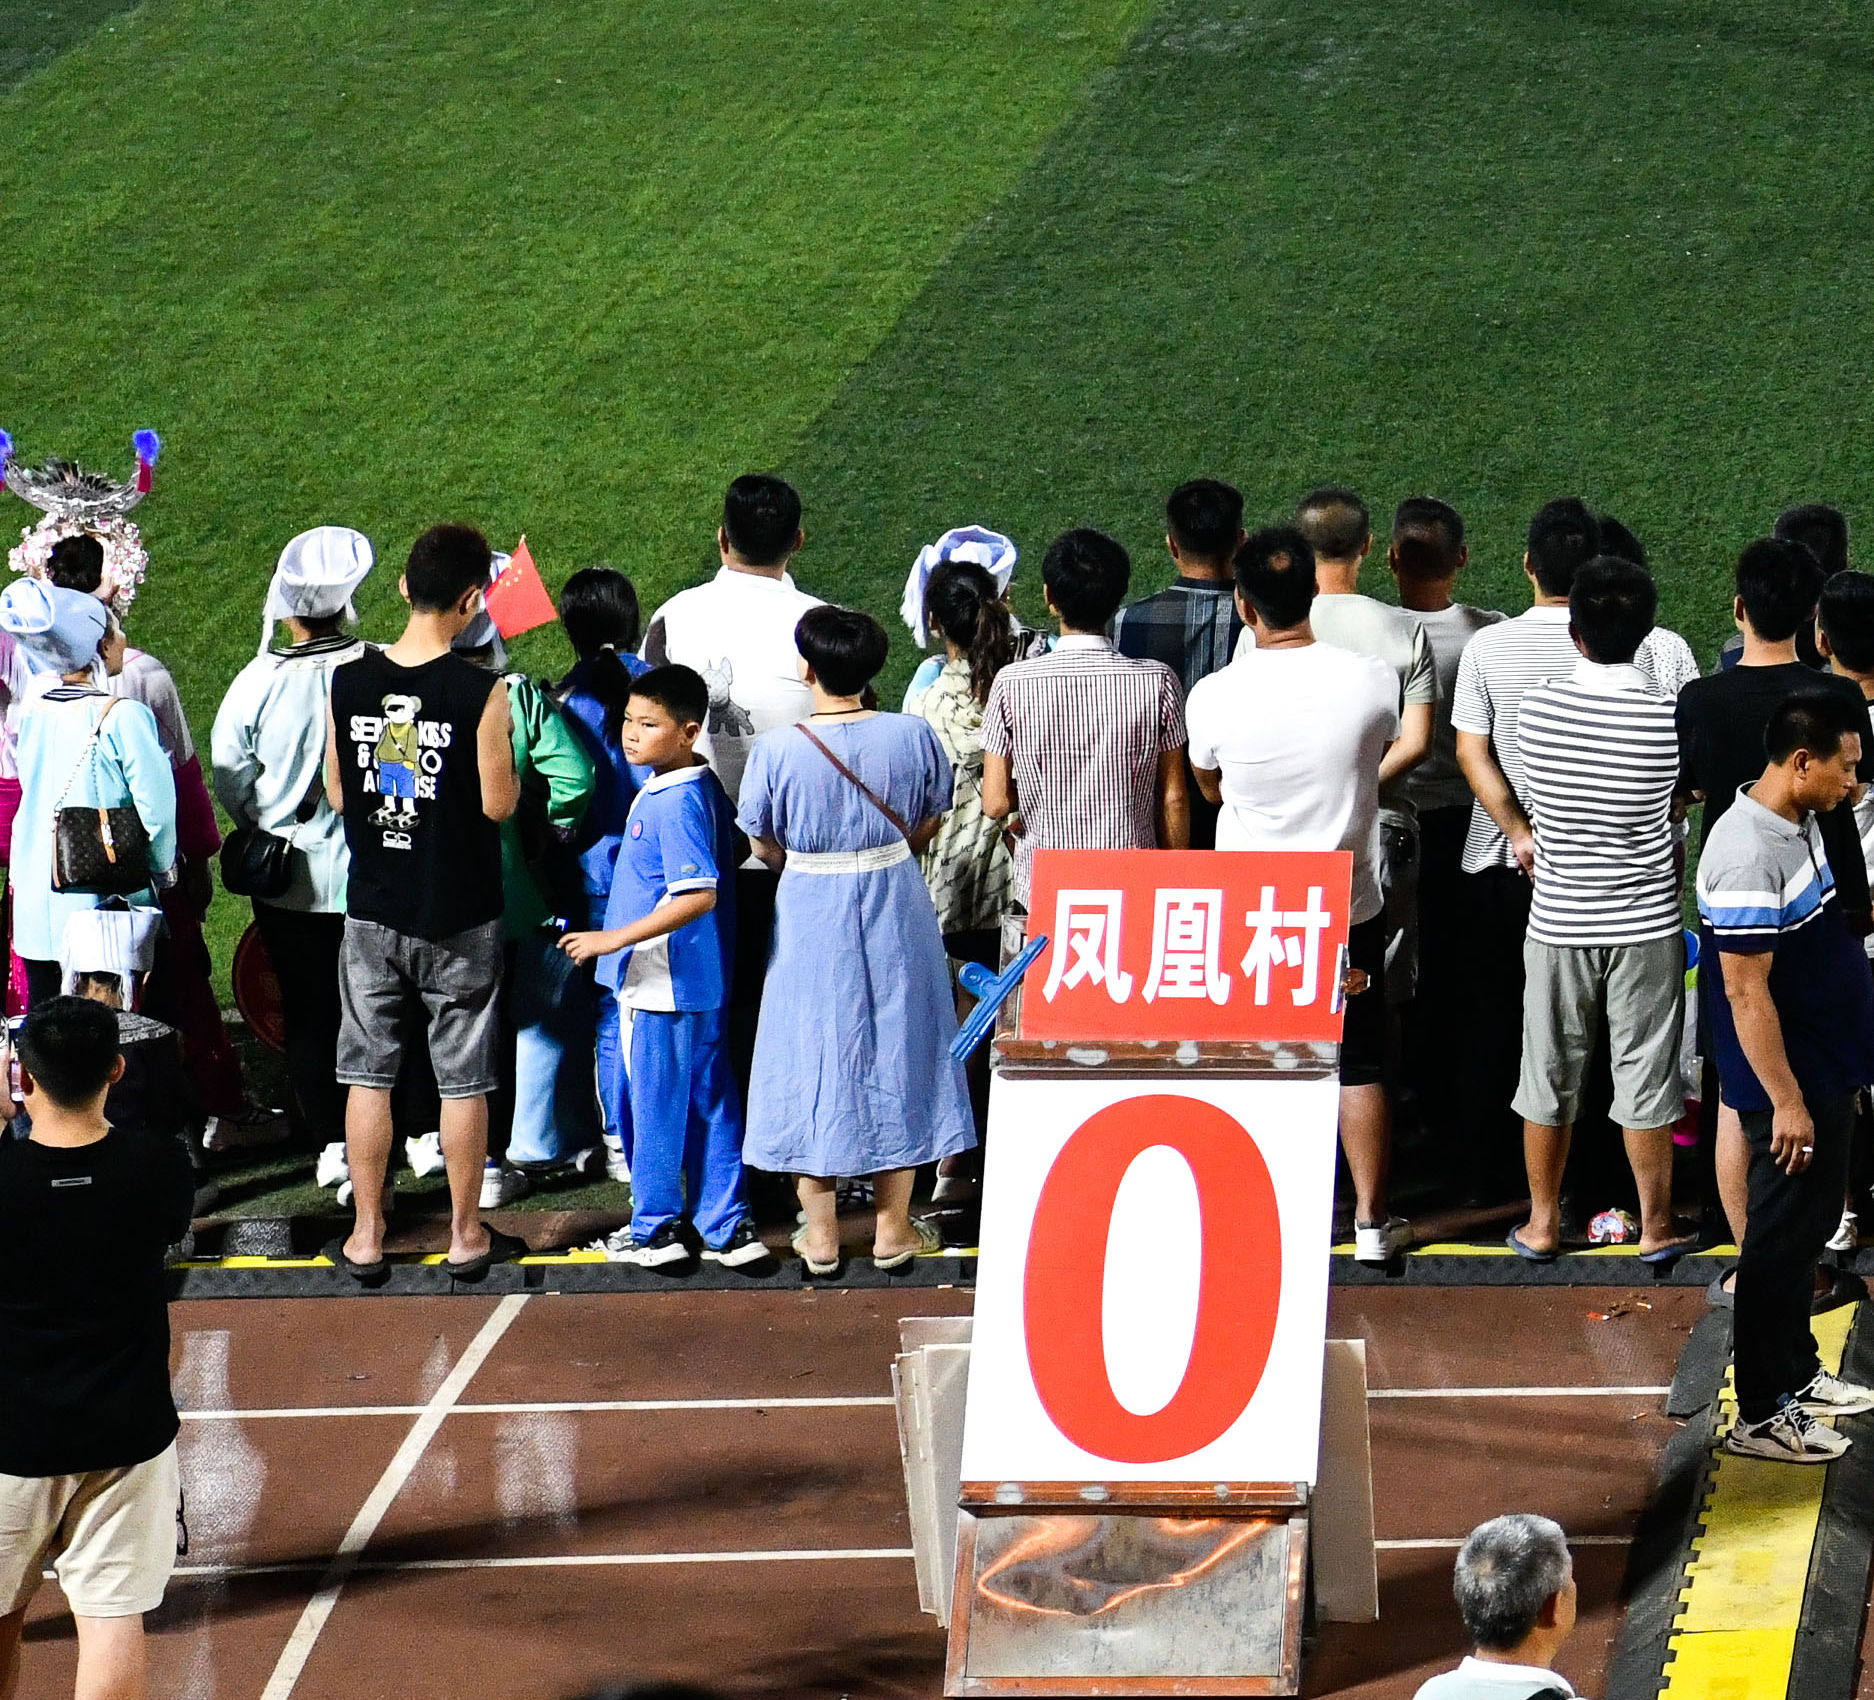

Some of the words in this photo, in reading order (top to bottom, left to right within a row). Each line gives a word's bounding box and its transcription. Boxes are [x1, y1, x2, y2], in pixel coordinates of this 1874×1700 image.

[1042, 885, 1332, 1006] 凤凰村
[1023, 1093, 1284, 1463] 0
